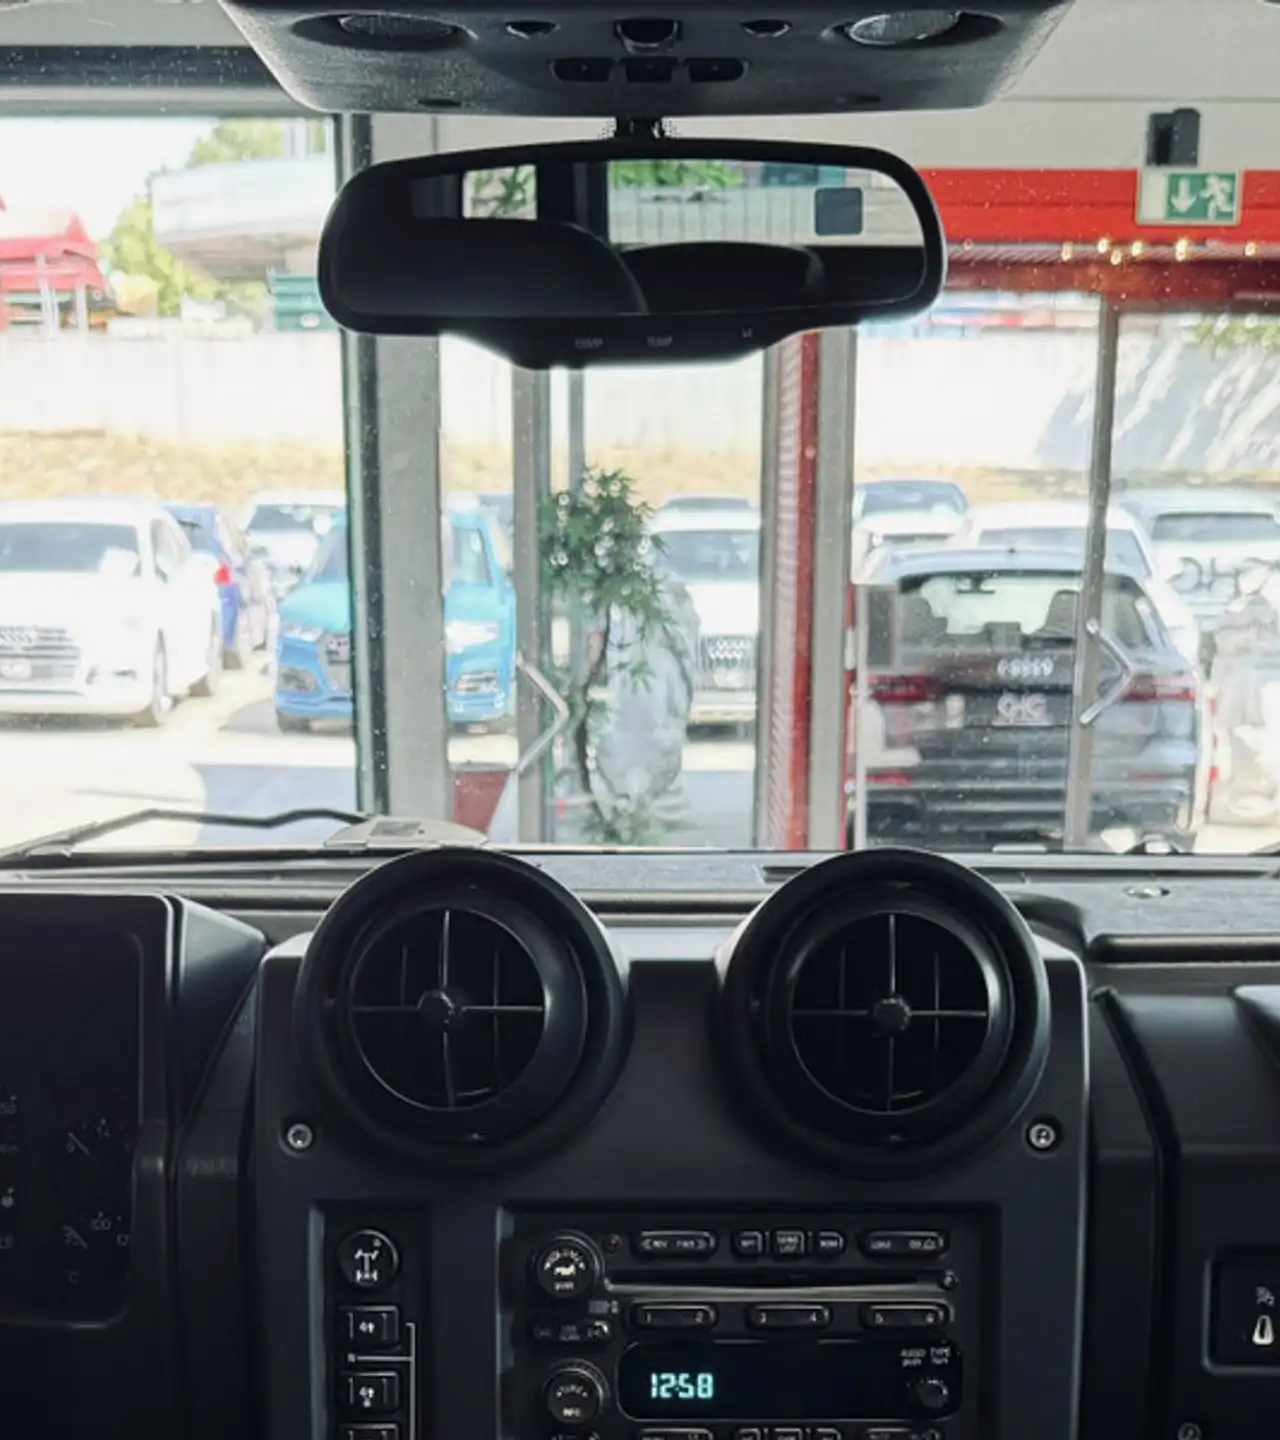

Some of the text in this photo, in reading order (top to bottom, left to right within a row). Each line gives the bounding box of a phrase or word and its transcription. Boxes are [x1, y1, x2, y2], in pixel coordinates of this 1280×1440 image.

[645, 1310, 705, 1325] 1 2
[758, 1311, 818, 1325] 3 4
[874, 1311, 936, 1325] 5 6
